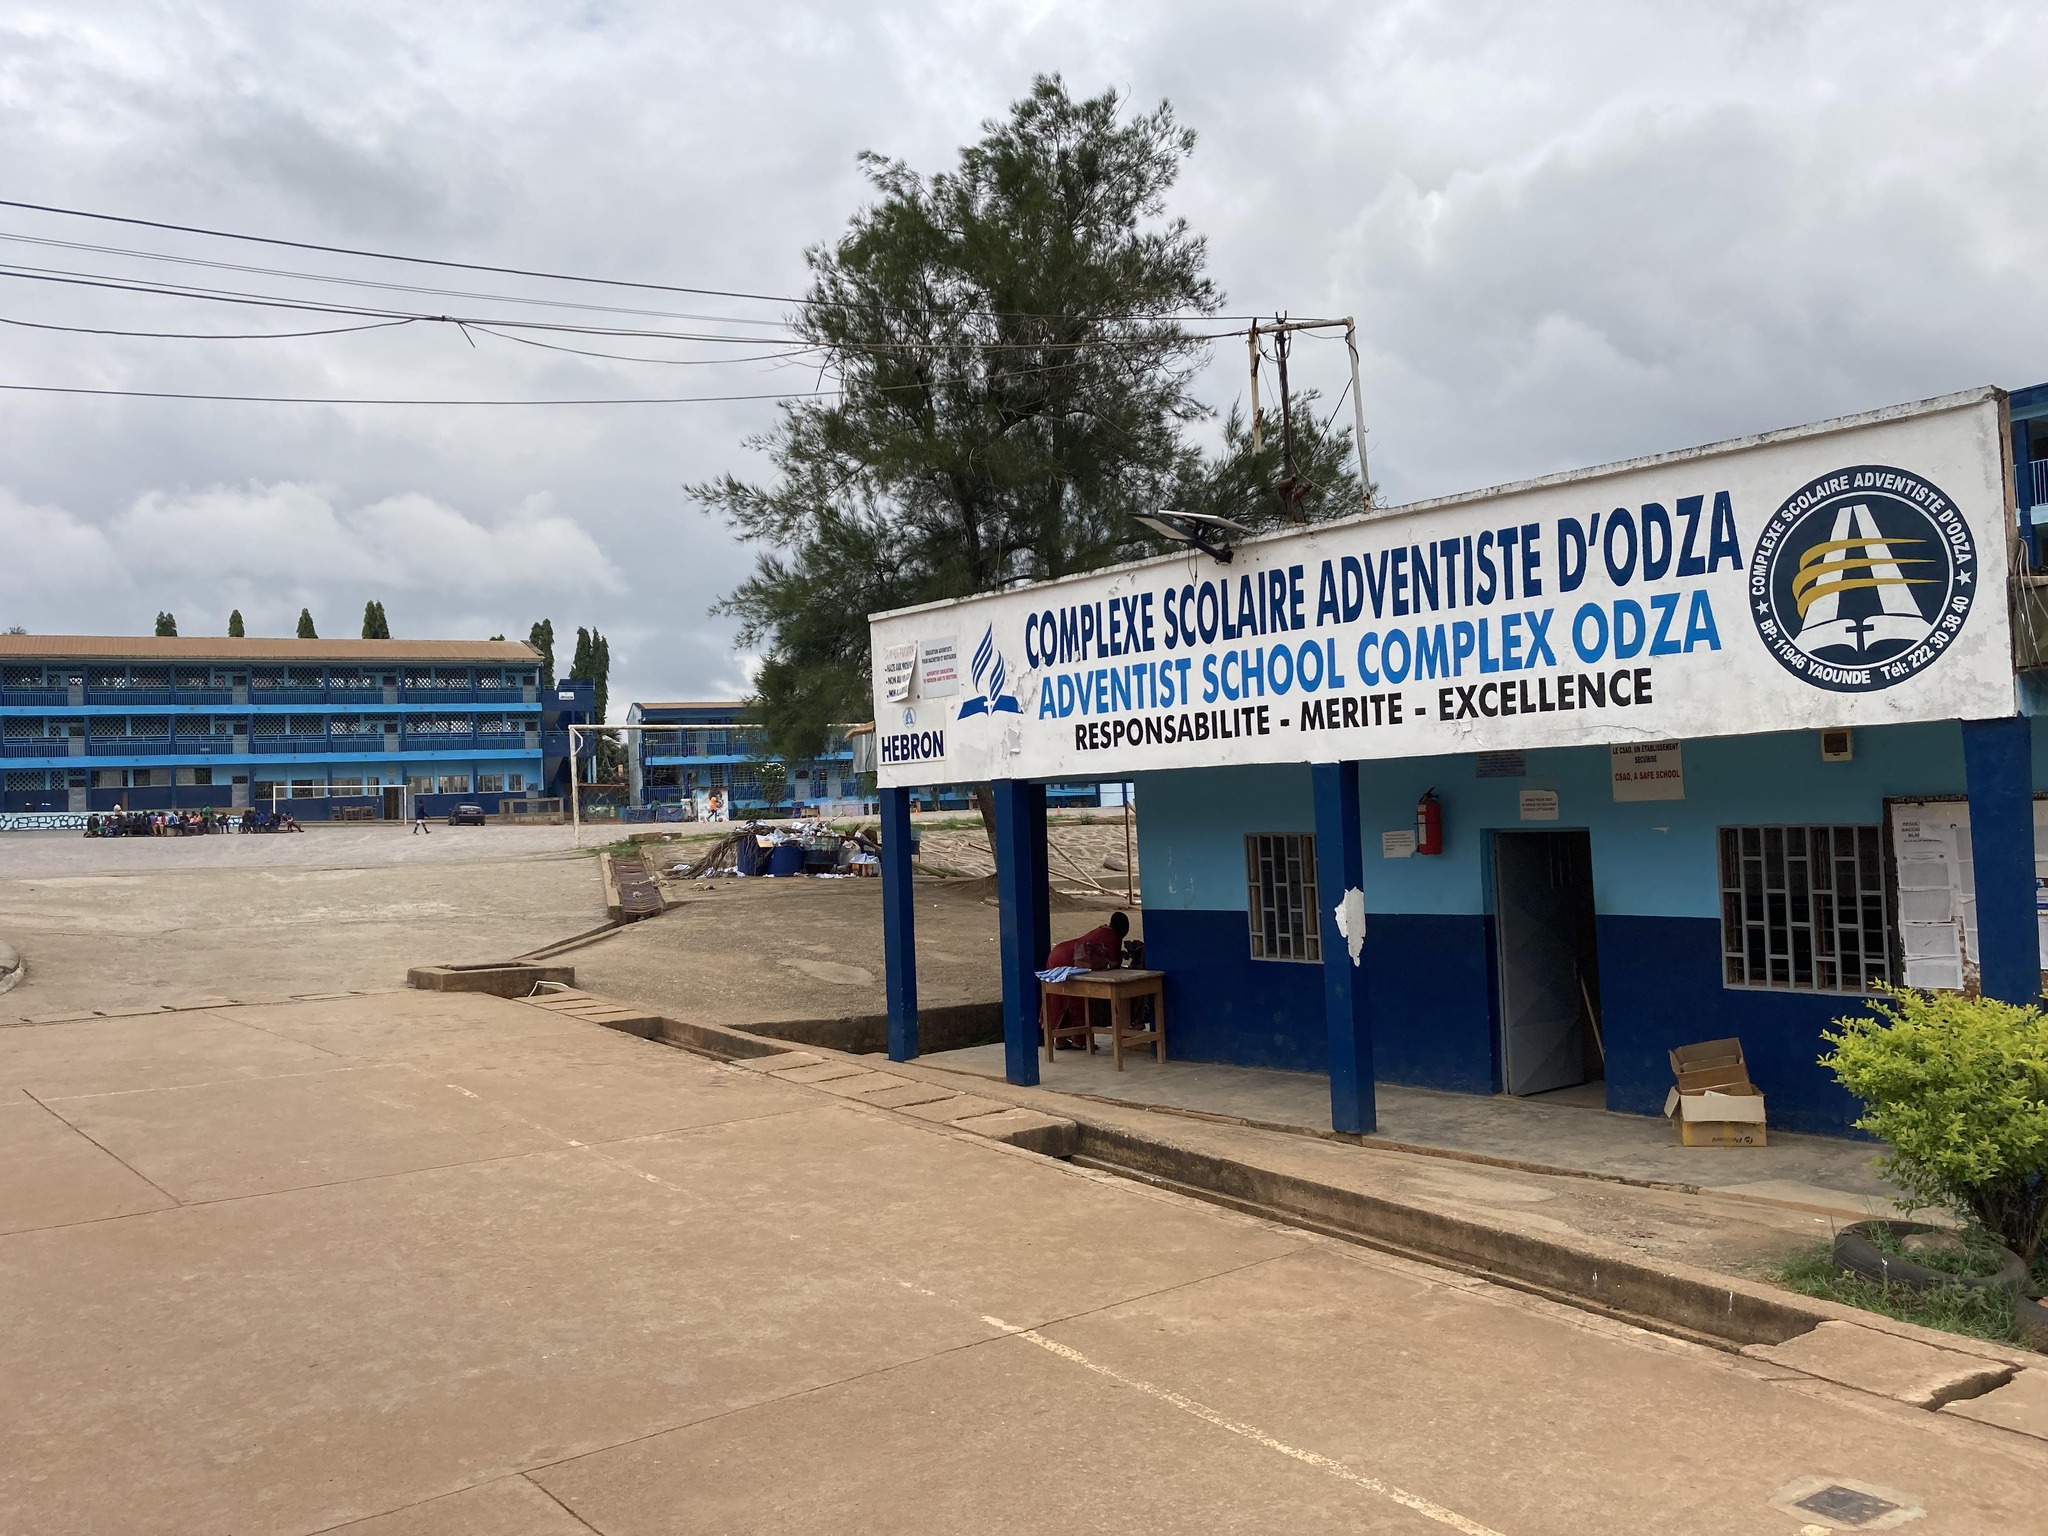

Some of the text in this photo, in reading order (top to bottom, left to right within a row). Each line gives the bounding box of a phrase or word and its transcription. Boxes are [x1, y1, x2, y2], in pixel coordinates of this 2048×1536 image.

[1751, 471, 1973, 596] COMPLEXE SCOLAIRE ADVENTISTE D'ODZA
[1025, 490, 1744, 670] COMPLEXE SCOLAIRE ADVENTISTE D'ODZA
[1038, 589, 1722, 720] ADVENTIST SCHOOL COMPLEX ODZA
[1759, 618, 1871, 685] BP: 11946 YAOUNDE
[1880, 595, 1970, 681] Tél: 222 30 38 40
[881, 730, 944, 763] HEBRON
[1075, 704, 1270, 750] RESPONSABILITE
[1300, 692, 1403, 731] MERITE
[1438, 668, 1653, 721] EXCELLENCE
[1634, 745, 1640, 753] UN
[1634, 772, 1638, 780] A
[1640, 771, 1654, 780] SAFE
[1656, 769, 1680, 779] SCHOOL
